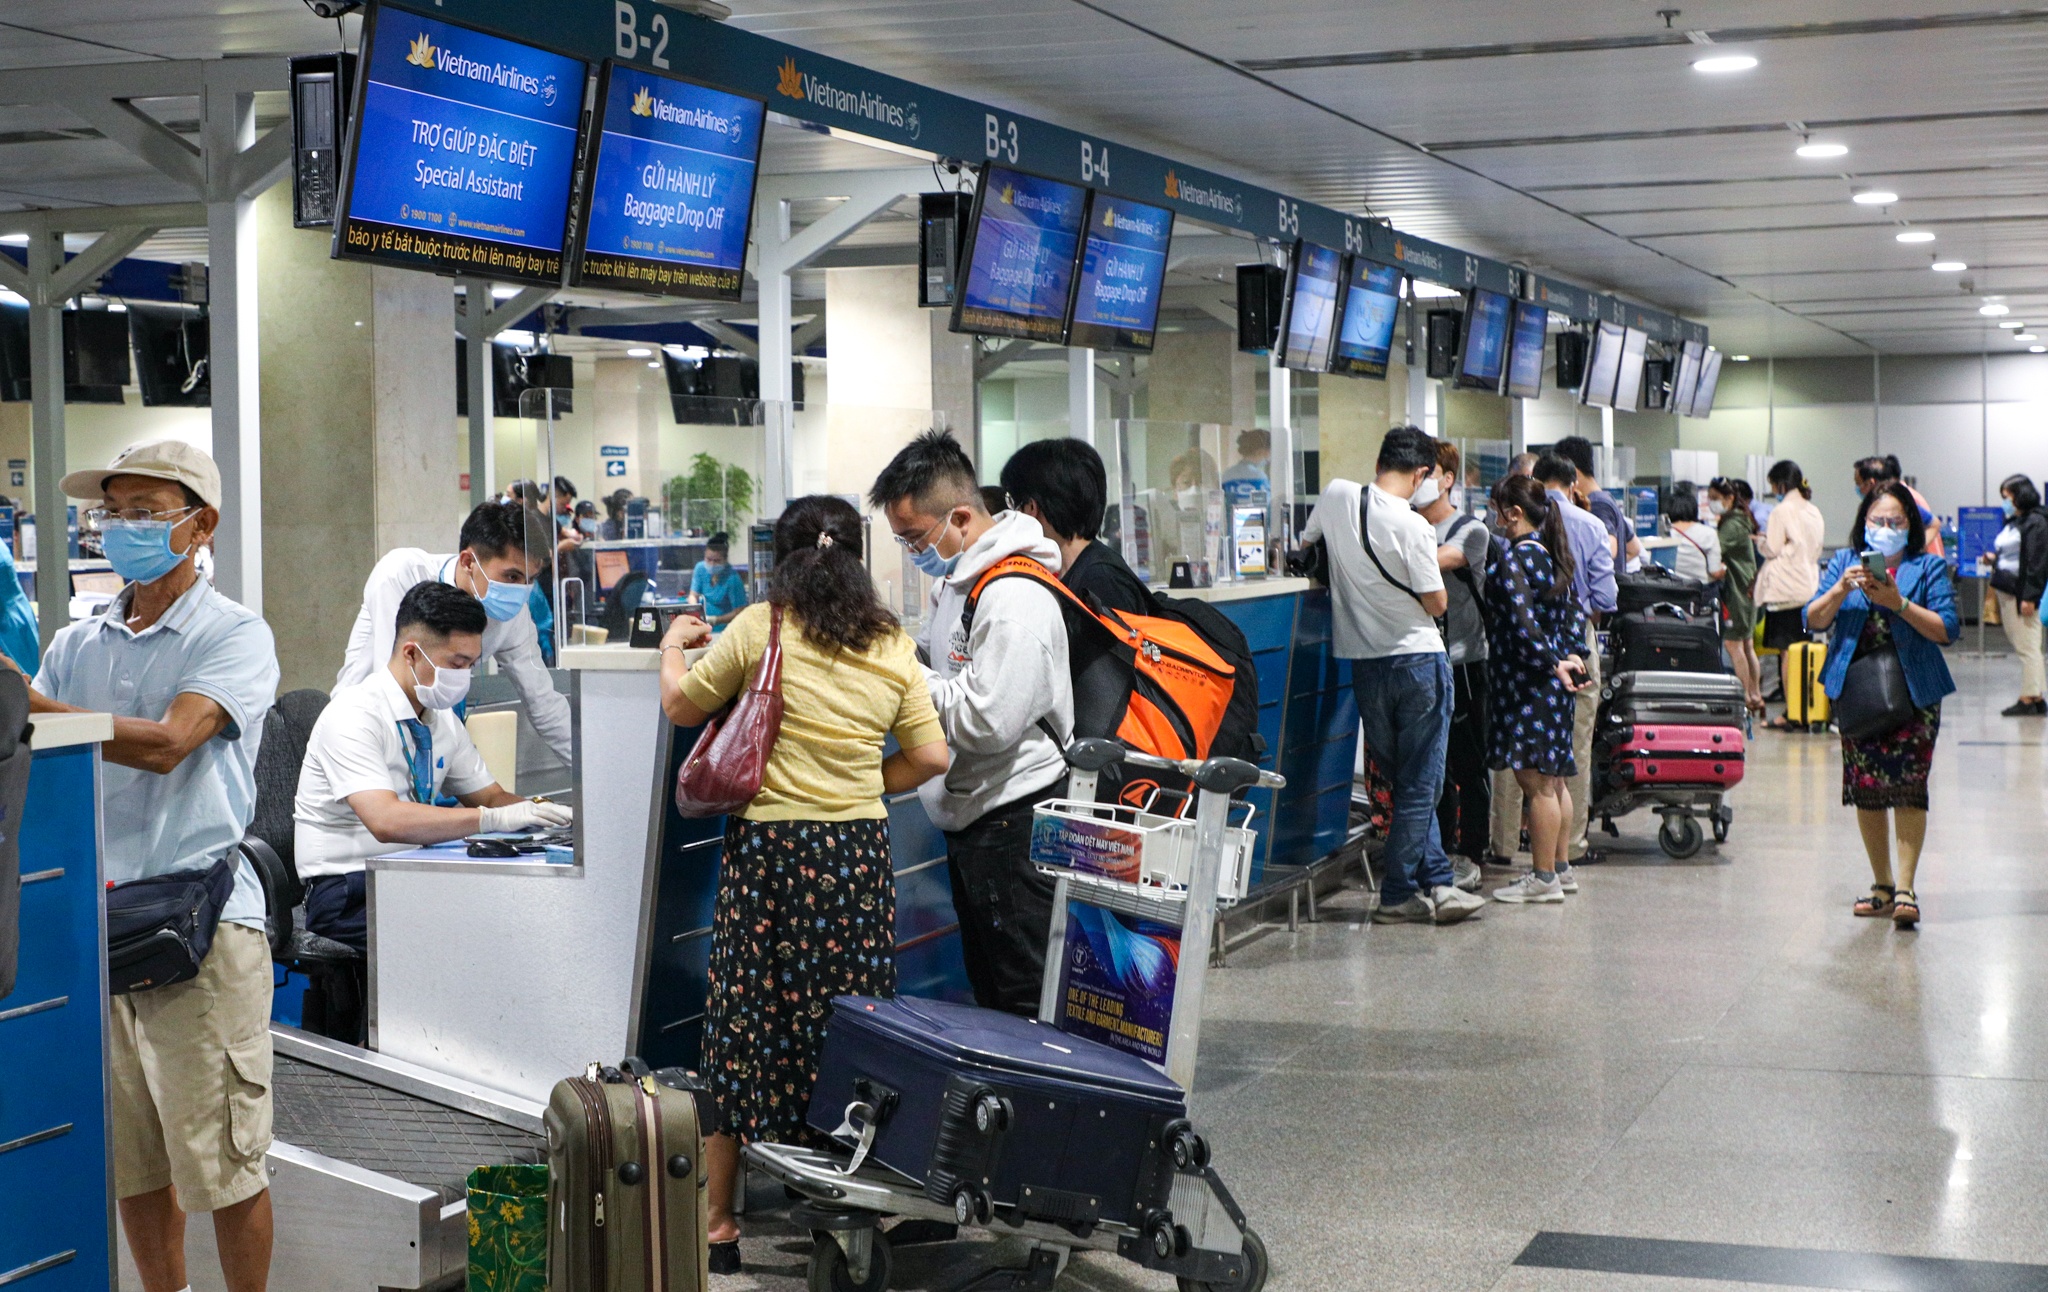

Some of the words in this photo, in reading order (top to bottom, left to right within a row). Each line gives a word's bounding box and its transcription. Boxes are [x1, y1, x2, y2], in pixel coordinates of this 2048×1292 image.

[615, 0, 670, 70] B-2
[411, 119, 442, 152] TRỢ
[442, 126, 477, 154] GIÚP
[477, 132, 508, 165] ĐẶC
[508, 140, 538, 170] BIỆT
[985, 113, 1019, 164] B-3
[414, 159, 465, 189] Special
[465, 169, 524, 201] Assistant
[642, 159, 666, 190] GỬI
[665, 166, 702, 196] HÀNH
[701, 172, 717, 199] LÝ
[1081, 140, 1110, 187] B-4
[411, 209, 427, 221] 1900
[427, 211, 443, 224] 1100
[457, 219, 526, 238] www.vietnamairlines.com
[624, 192, 675, 229] Baggage
[676, 201, 705, 233] Drop
[705, 206, 725, 231] Off
[1278, 198, 1299, 236] B-5
[348, 225, 370, 246] báo
[371, 233, 380, 251] y
[381, 230, 395, 250] tế
[394, 231, 414, 252] bắt
[414, 235, 441, 260] buộc
[443, 241, 470, 261] trước
[471, 243, 488, 265] khi
[489, 249, 504, 266] lên
[505, 251, 527, 274] máy
[527, 252, 546, 276] bay
[1344, 218, 1363, 254] B-6
[590, 259, 613, 276] trước
[613, 260, 627, 278] khi
[627, 262, 640, 279] lên
[640, 264, 658, 285] máy
[658, 265, 672, 287] bay
[672, 268, 688, 284] trên
[689, 270, 717, 288] website
[717, 272, 731, 290] của
[1465, 255, 1479, 284] B-7
[1096, 837, 1108, 851] MAY
[1121, 843, 1135, 857] NAM
[1066, 1001, 1086, 1020] TEXTILE
[1086, 1008, 1097, 1025] AND
[1068, 986, 1079, 1001] ONE
[1080, 989, 1088, 1004] OF
[1088, 992, 1099, 1009] THE
[1099, 996, 1124, 1018] LEADING
